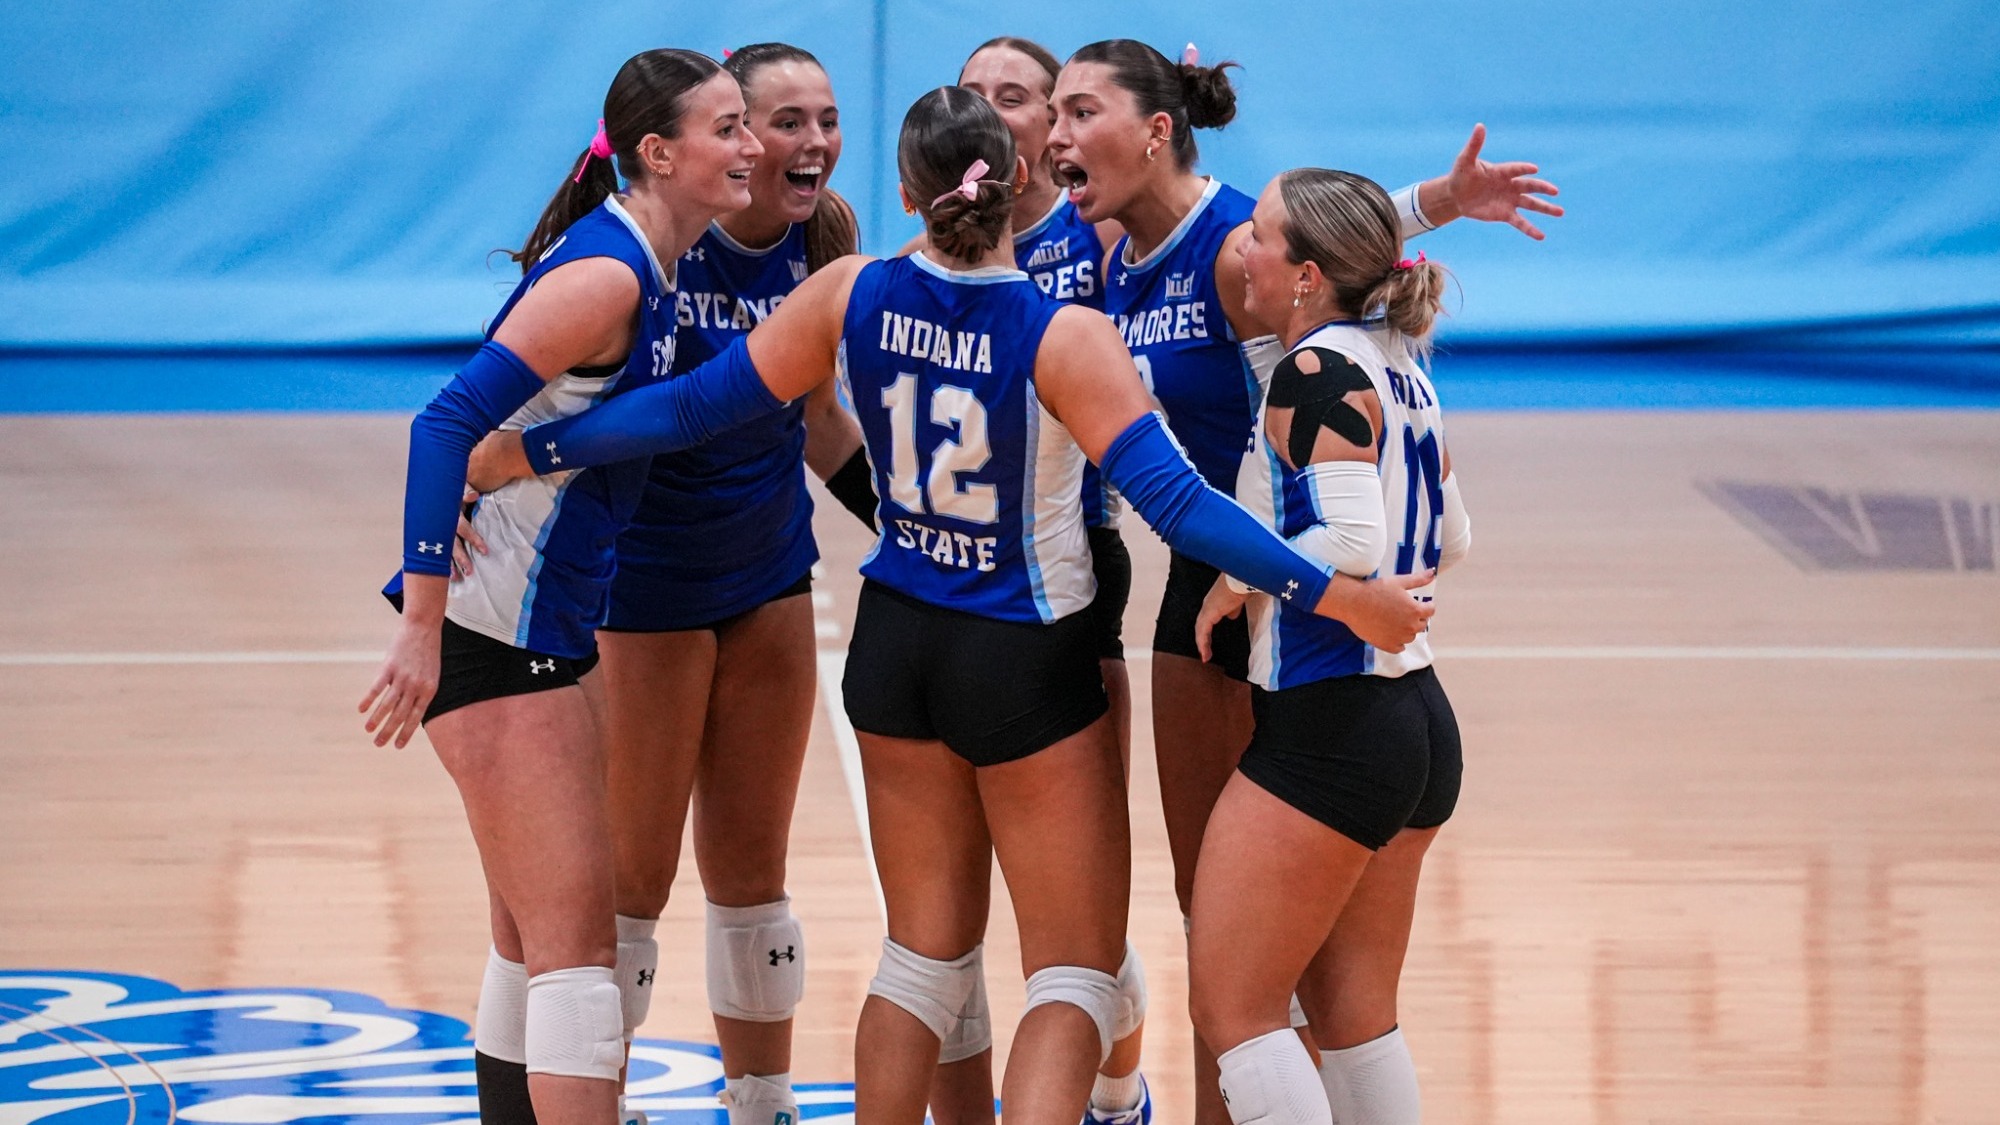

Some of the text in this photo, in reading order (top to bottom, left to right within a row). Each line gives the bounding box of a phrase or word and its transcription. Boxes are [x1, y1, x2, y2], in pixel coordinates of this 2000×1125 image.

[1165, 270, 1195, 298] VLLEY
[880, 310, 992, 374] INDIANA
[1106, 302, 1208, 348] AMORES
[881, 371, 1000, 525] 12
[894, 519, 997, 573] STATE
